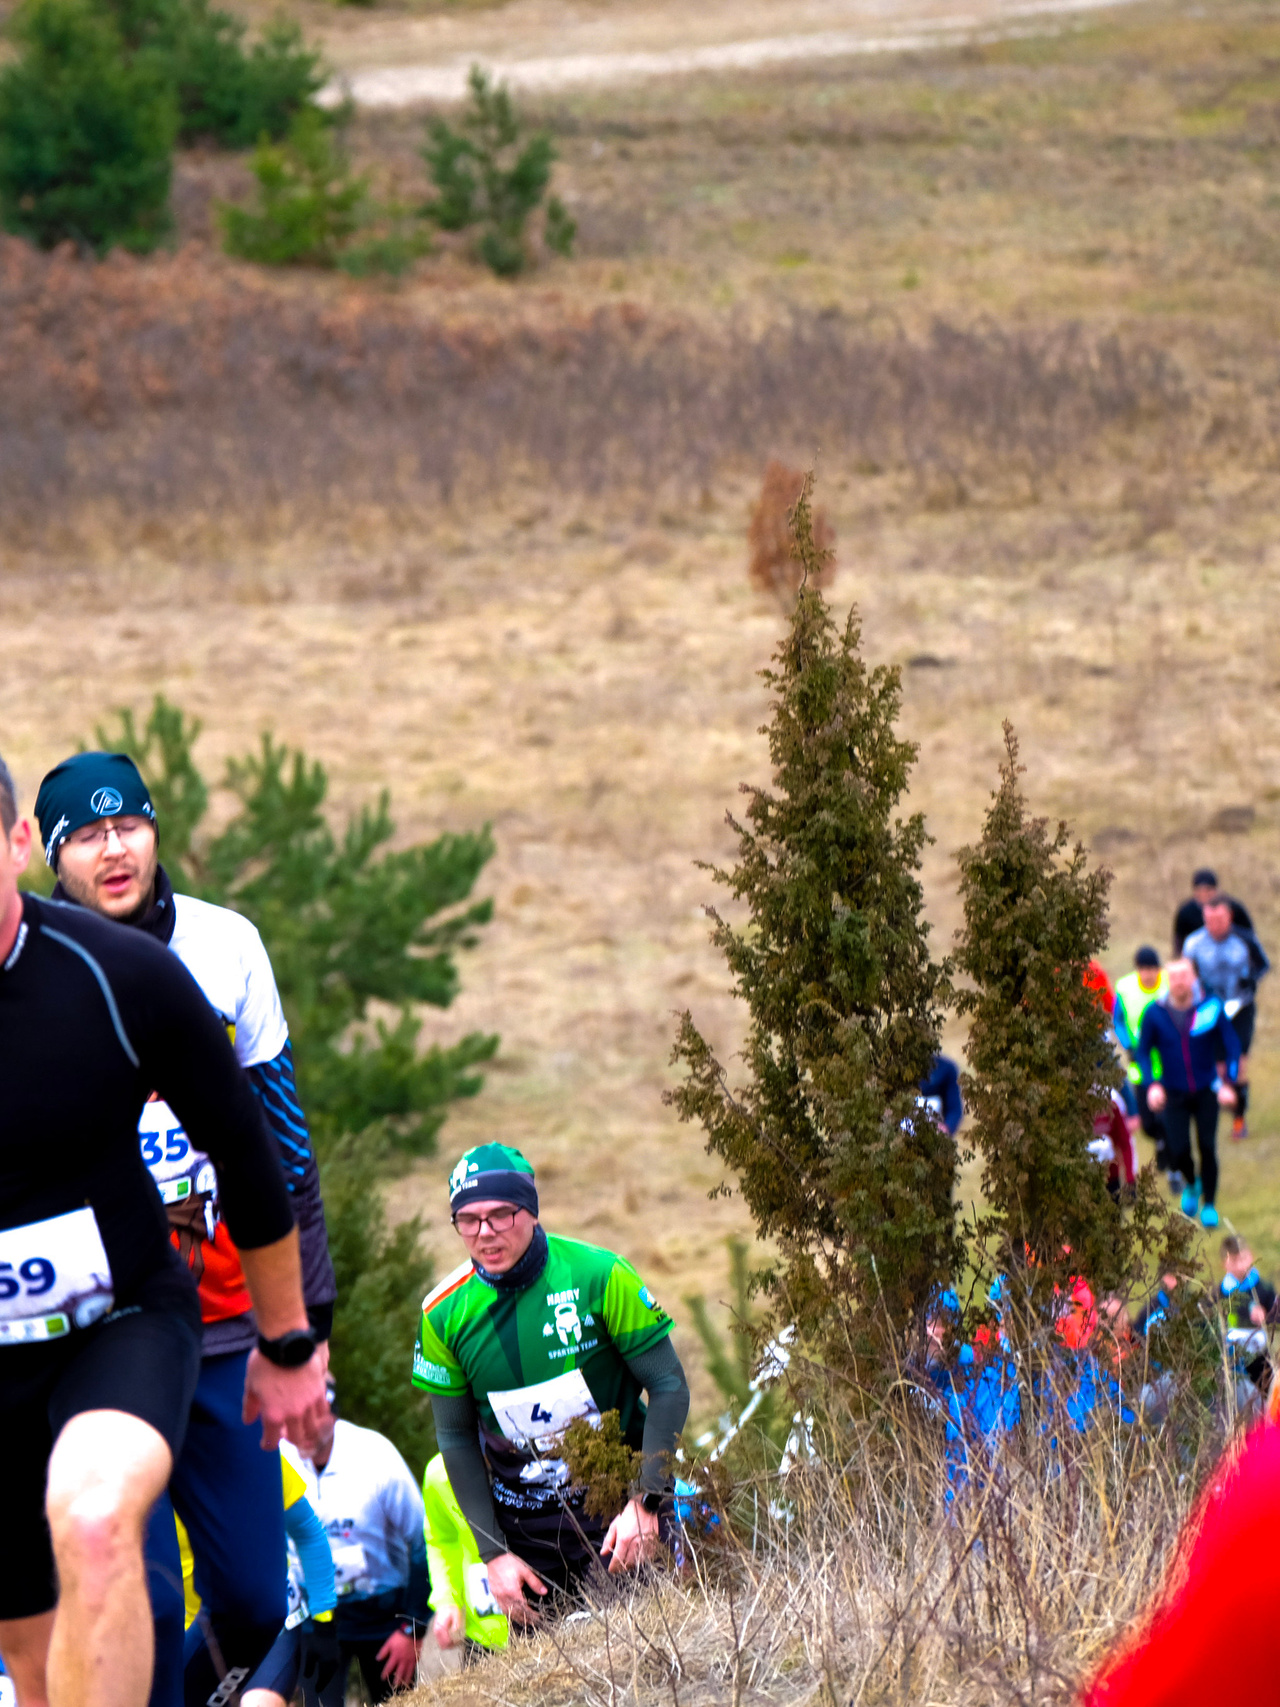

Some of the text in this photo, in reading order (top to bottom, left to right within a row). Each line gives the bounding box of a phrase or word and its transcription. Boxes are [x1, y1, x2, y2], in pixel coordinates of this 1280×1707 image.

[547, 1288, 580, 1306] HARRY
[548, 1338, 599, 1360] SPARTAN TEAM
[531, 1403, 552, 1423] 4
